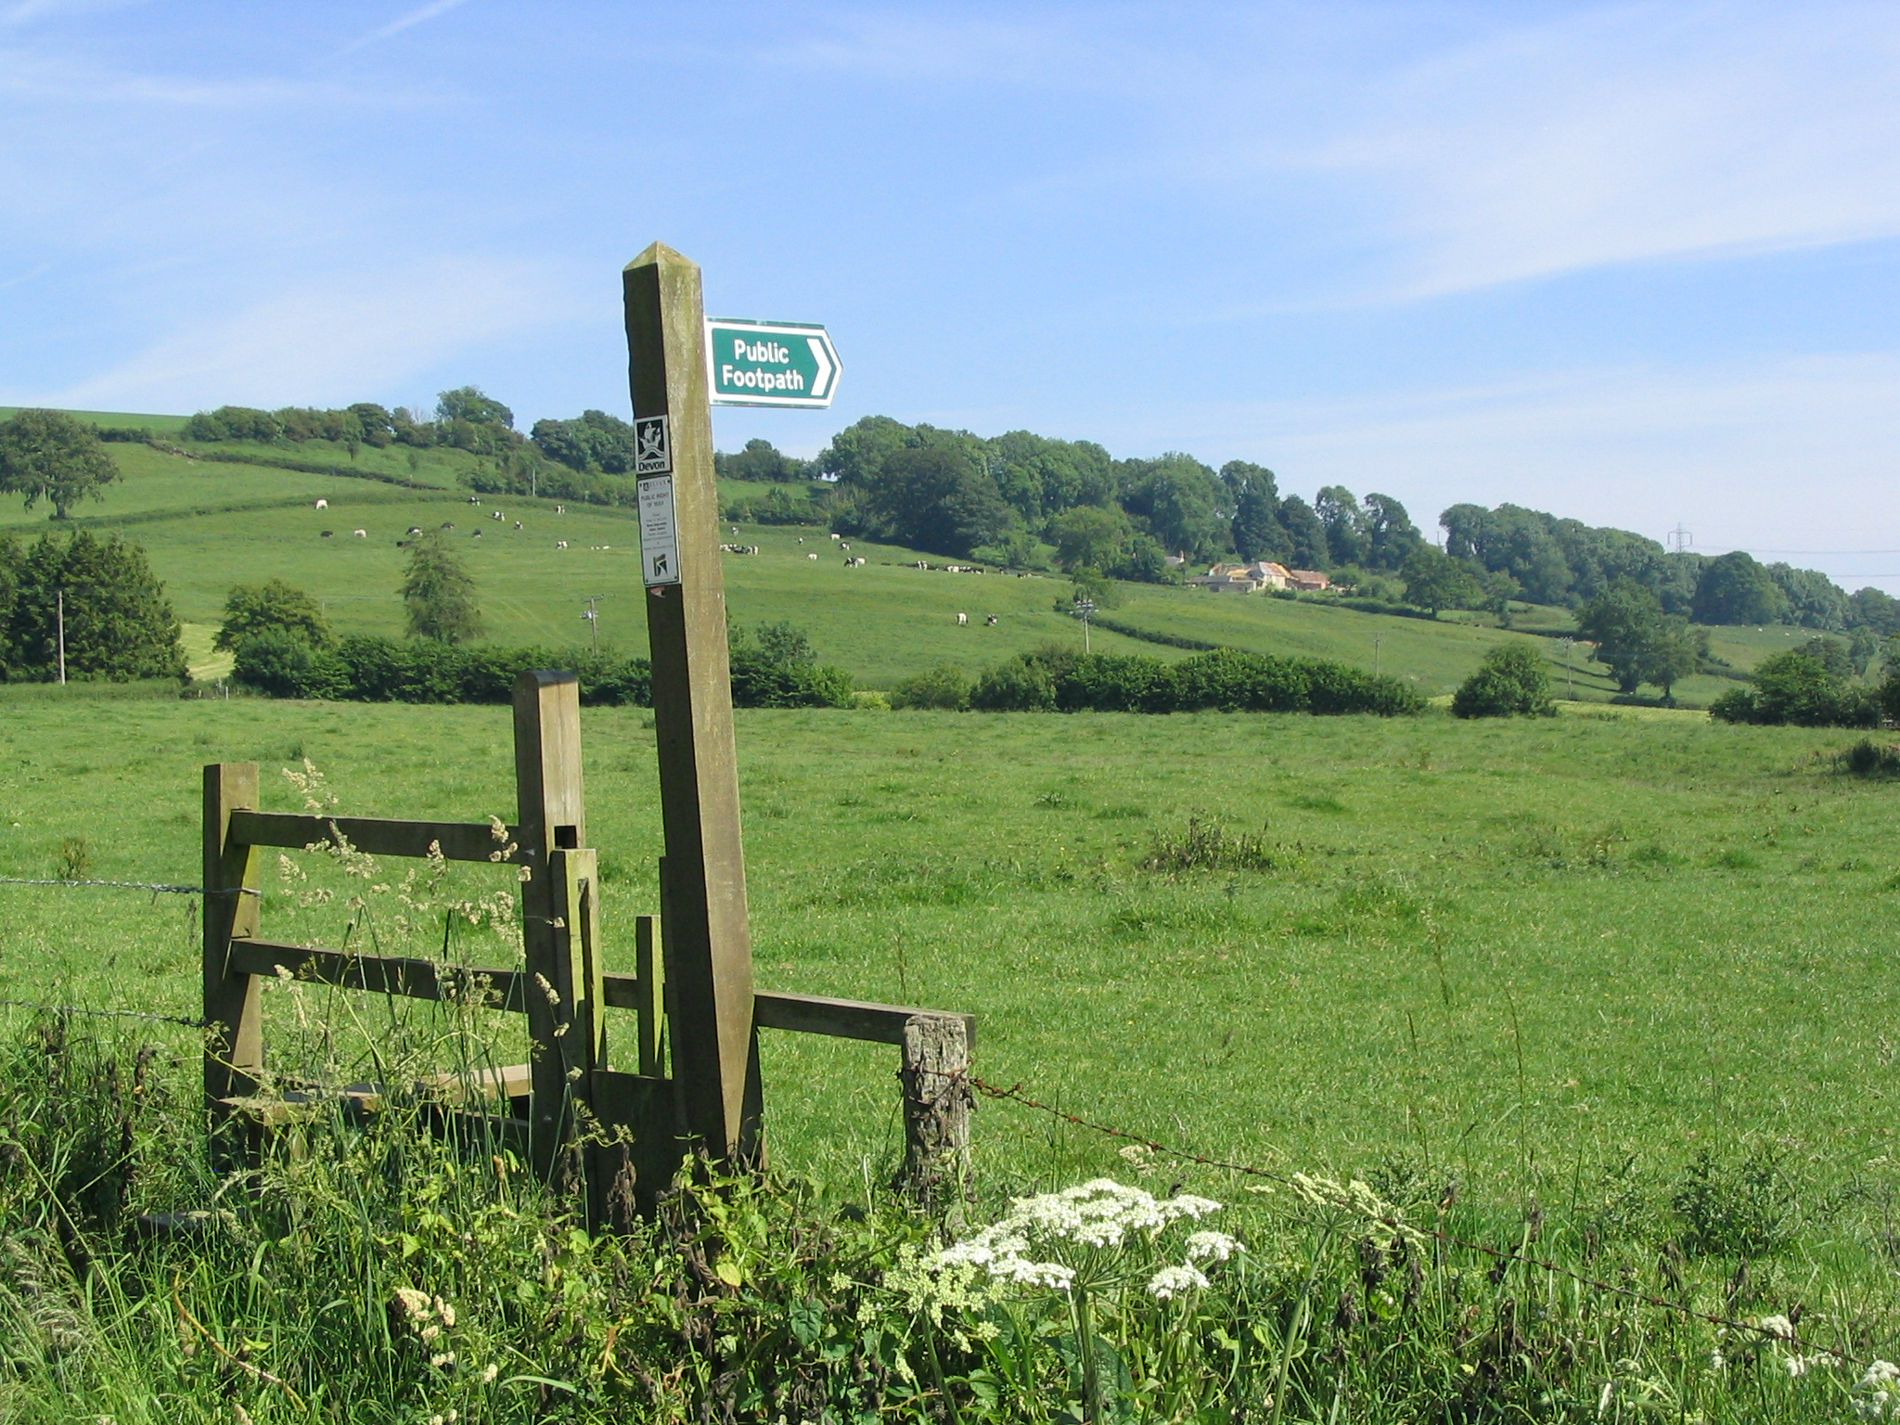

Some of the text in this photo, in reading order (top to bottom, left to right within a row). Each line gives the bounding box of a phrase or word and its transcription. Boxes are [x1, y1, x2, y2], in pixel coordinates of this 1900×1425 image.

[734, 339, 789, 364] Public
[722, 365, 804, 392] Footpath
[638, 461, 665, 471] Devon
